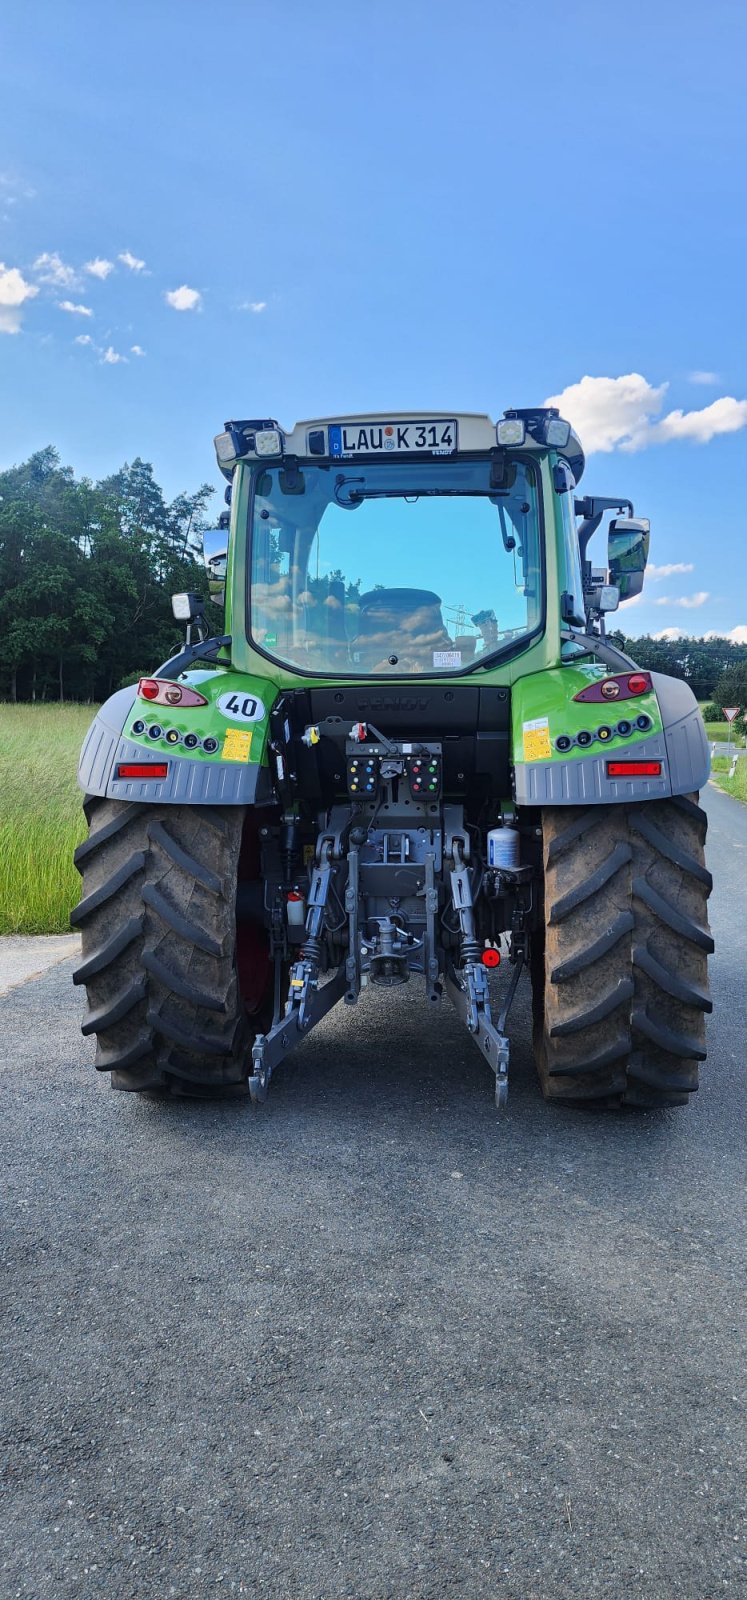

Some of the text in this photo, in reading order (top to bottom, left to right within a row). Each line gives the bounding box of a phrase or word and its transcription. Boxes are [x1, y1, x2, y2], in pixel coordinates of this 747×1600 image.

[343, 425, 453, 450] LAU K 314
[333, 443, 339, 451] D
[225, 695, 257, 717] 40
[357, 696, 431, 711] FENDT
